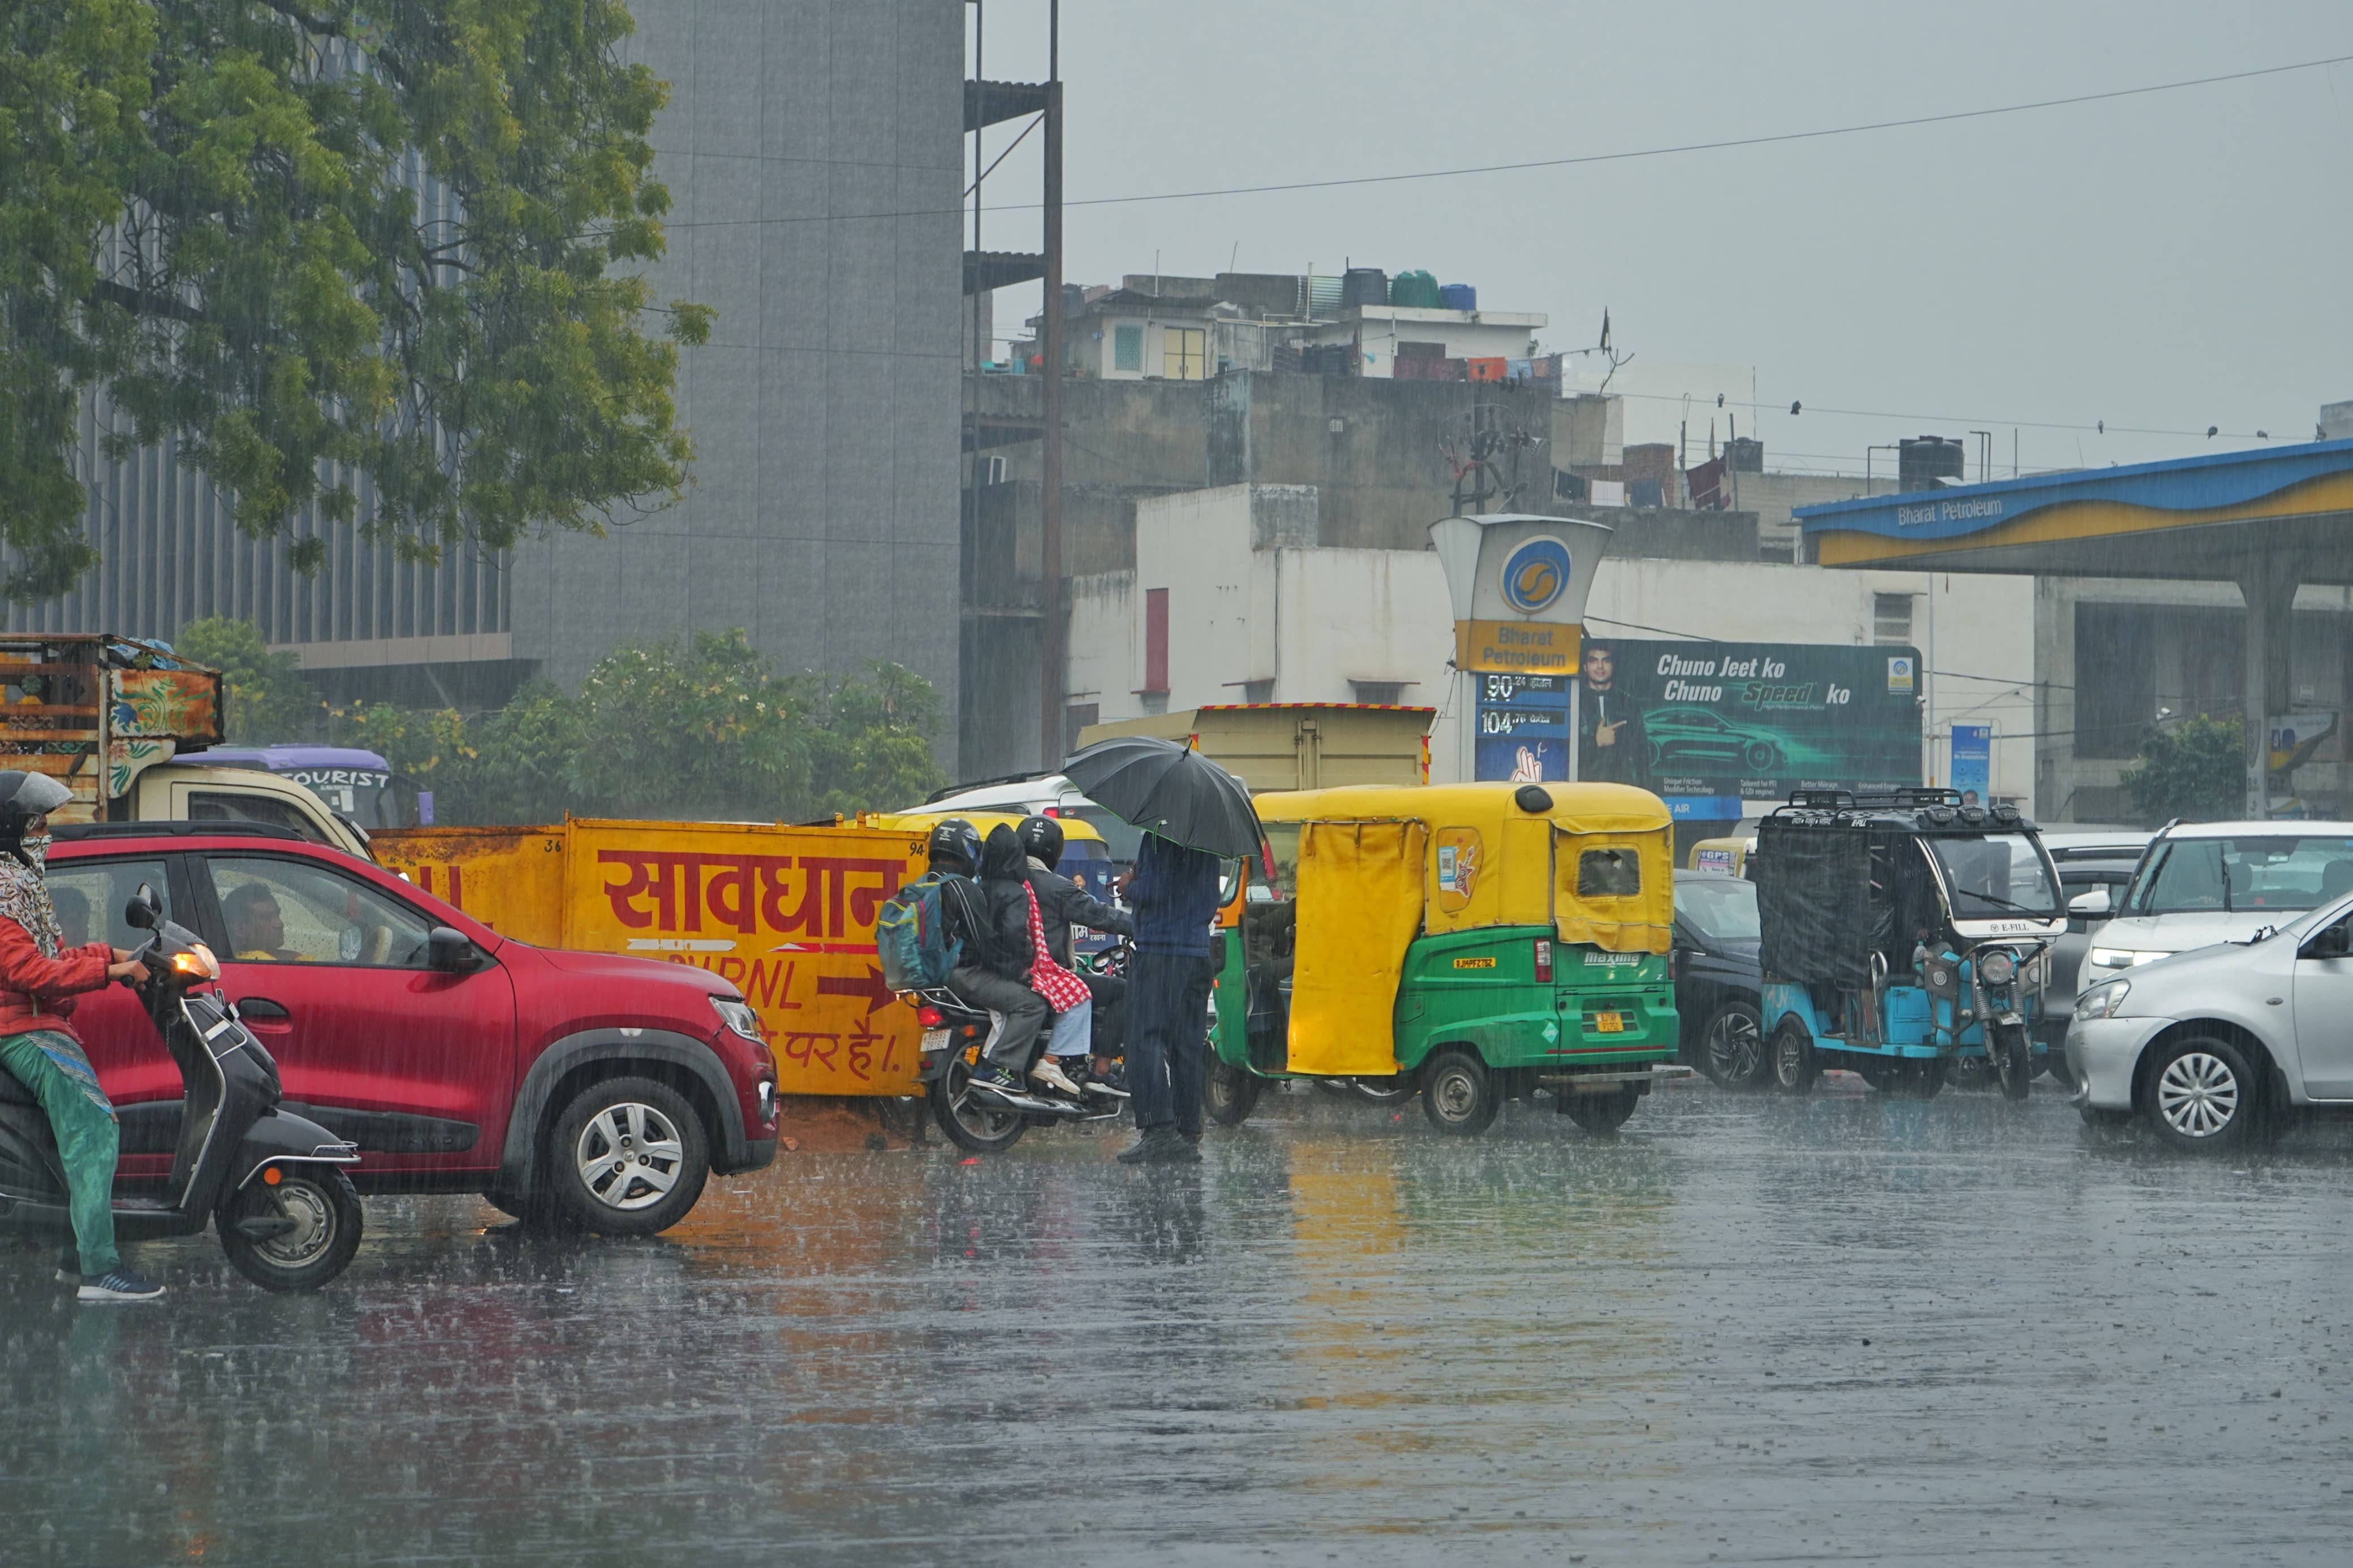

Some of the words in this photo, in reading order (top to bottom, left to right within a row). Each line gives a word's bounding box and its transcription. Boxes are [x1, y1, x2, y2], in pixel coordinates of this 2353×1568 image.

[1898, 504, 1937, 526] Bharat
[1942, 498, 2002, 521] Petroleum
[1499, 627, 1553, 646] Bharat
[1484, 647, 1566, 667] Petroleum
[1657, 654, 1716, 676] Chuno
[1718, 656, 1758, 677] Jeet
[1761, 658, 1786, 679] ko
[1664, 680, 1722, 702] Chuno
[1742, 680, 1813, 711] Speed
[1826, 684, 1851, 704] ko
[1664, 777, 1682, 787] Unique
[1686, 786, 1714, 794] Technology
[1674, 804, 1690, 813] AIR
[544, 840, 562, 852] 36
[910, 842, 925, 857] 94
[1706, 851, 1729, 859] GPS
[598, 849, 907, 939] सावधान
[785, 1032, 841, 1072] पर
